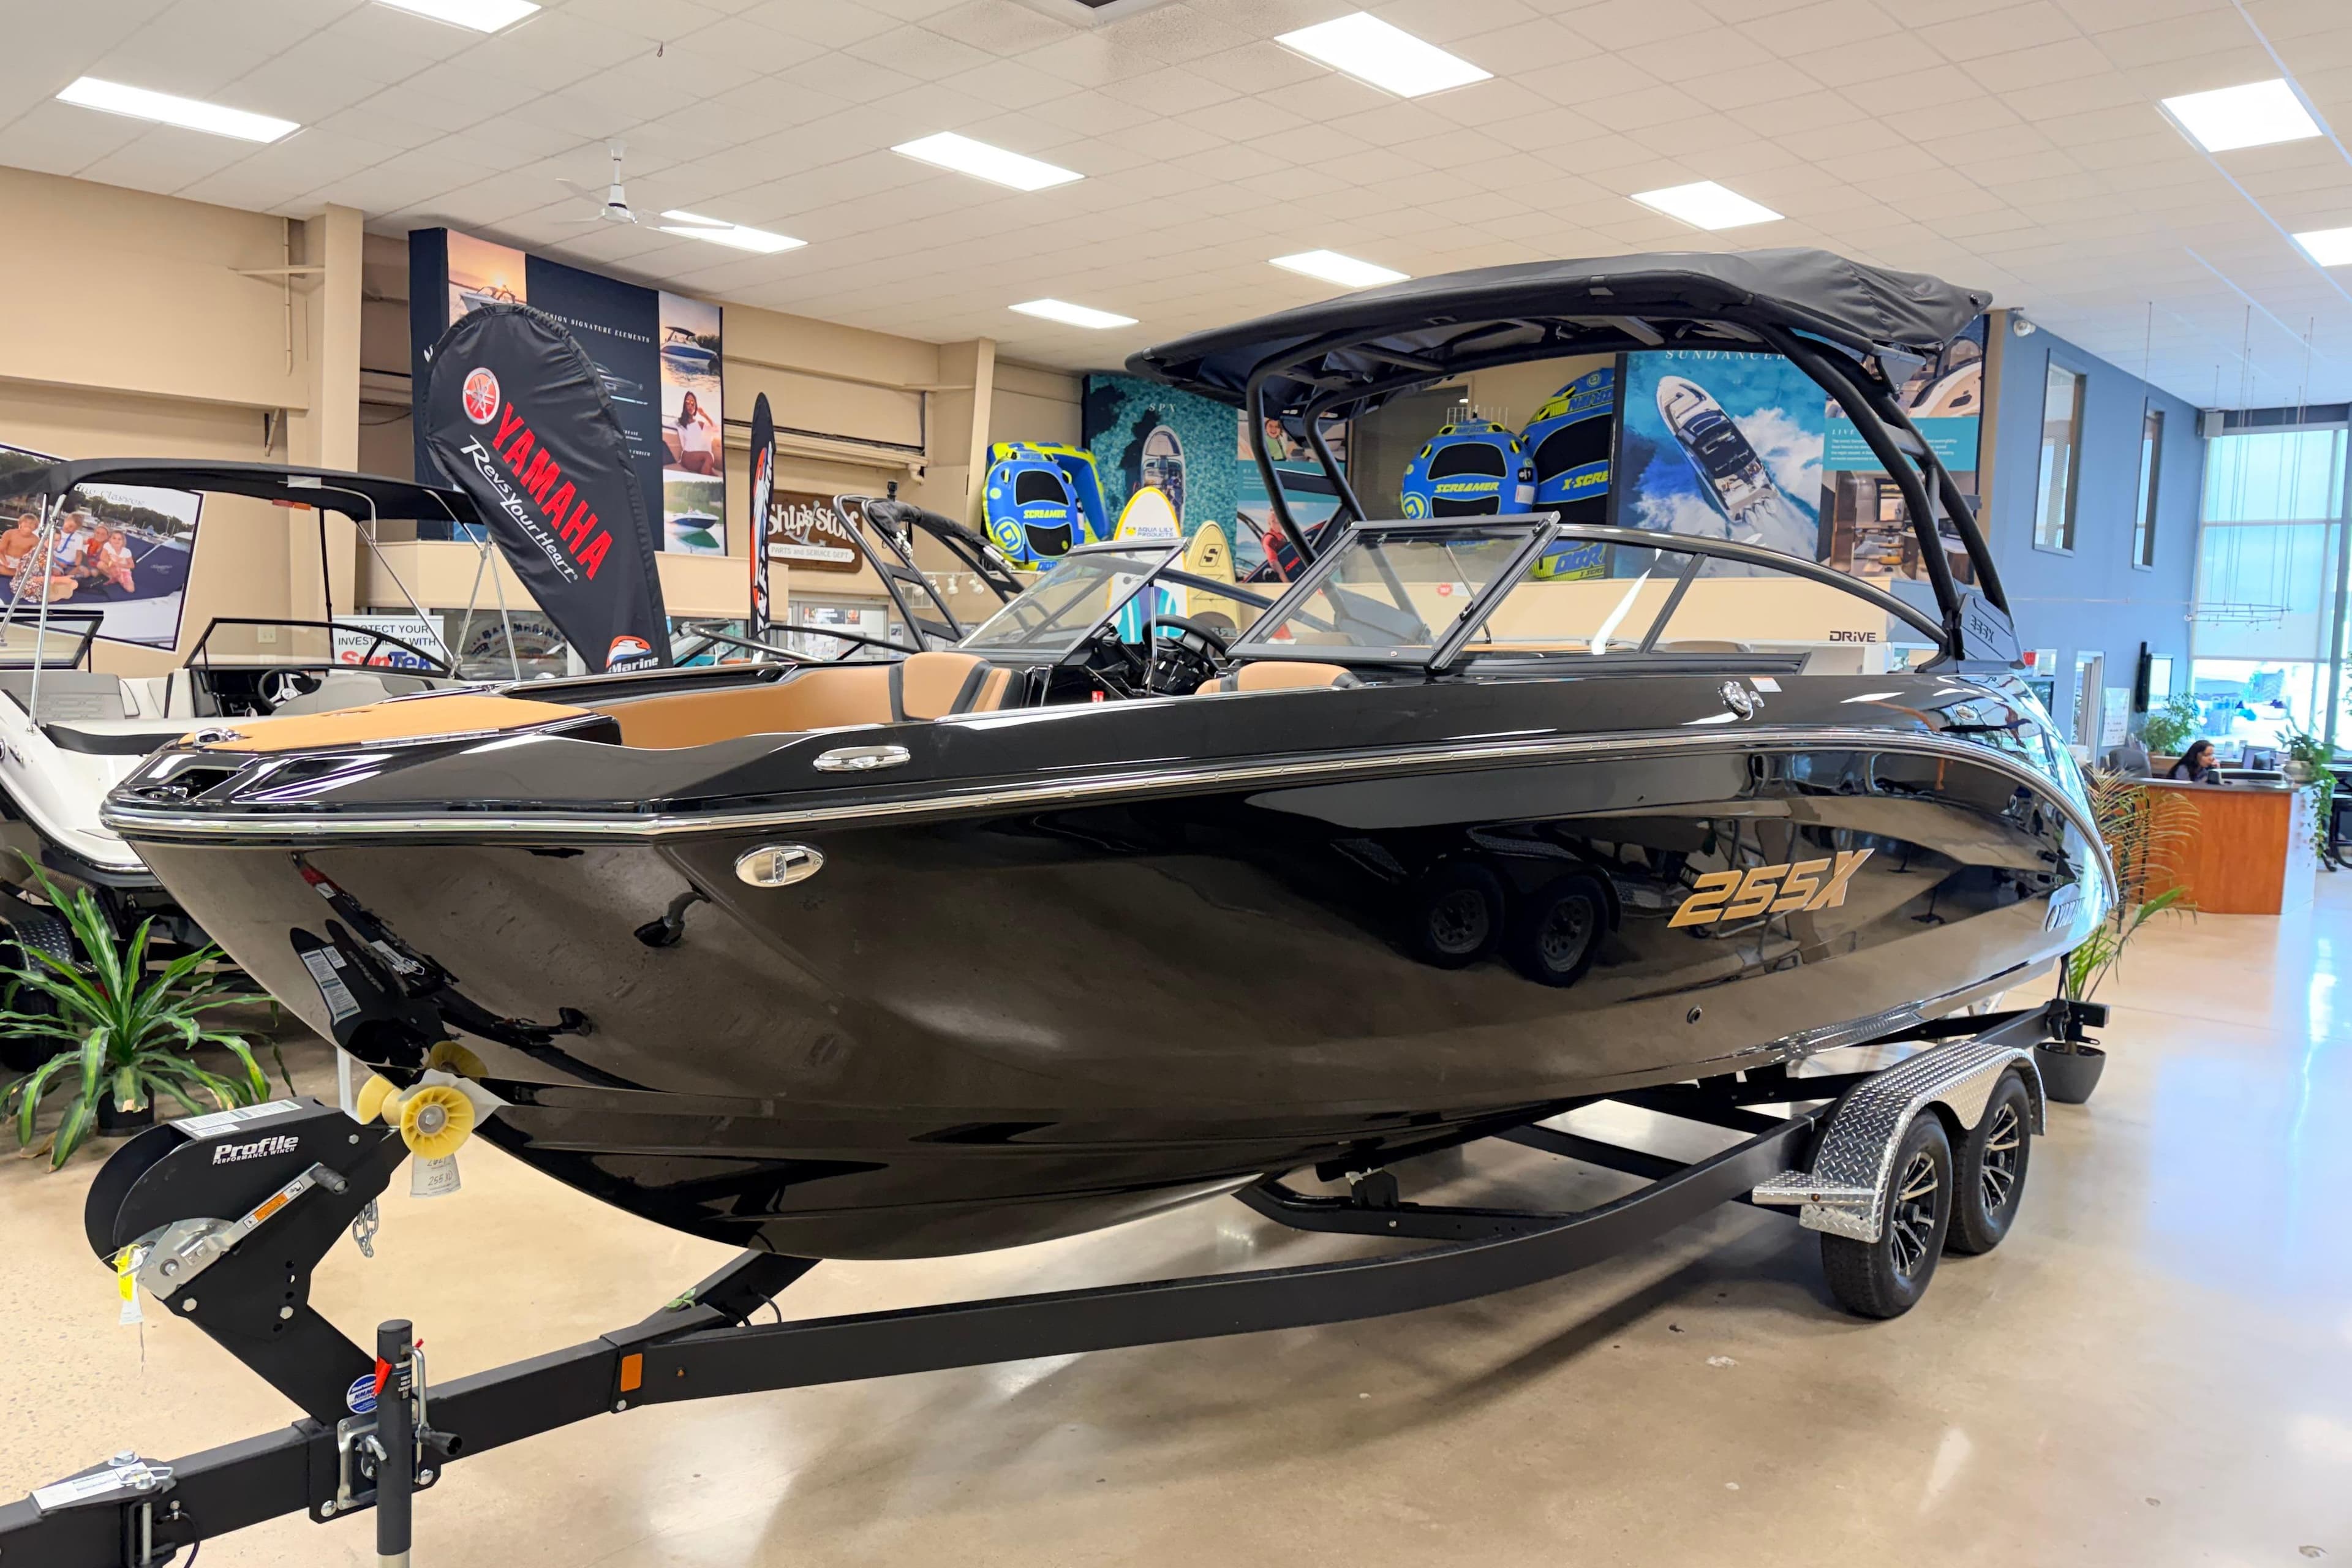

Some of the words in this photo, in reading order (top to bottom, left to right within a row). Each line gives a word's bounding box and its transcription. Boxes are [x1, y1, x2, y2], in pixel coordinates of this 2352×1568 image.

[571, 319, 612, 334] SIGNATURE
[614, 330, 650, 344] ELEMENTS
[1148, 402, 1176, 412] SPX
[492, 402, 612, 581] YAMAHA
[1434, 481, 1499, 493] SCREAMER
[1023, 510, 1067, 519] SCREAMER
[771, 546, 791, 555] PARTS
[806, 549, 831, 558] SERVICE
[399, 625, 429, 634] YOUR
[610, 657, 659, 674] Marine
[1667, 848, 1875, 928] 255X
[212, 1152, 268, 1165] PERFORMANCE
[270, 1145, 295, 1156] WINCH
[214, 1135, 300, 1159] Profile
